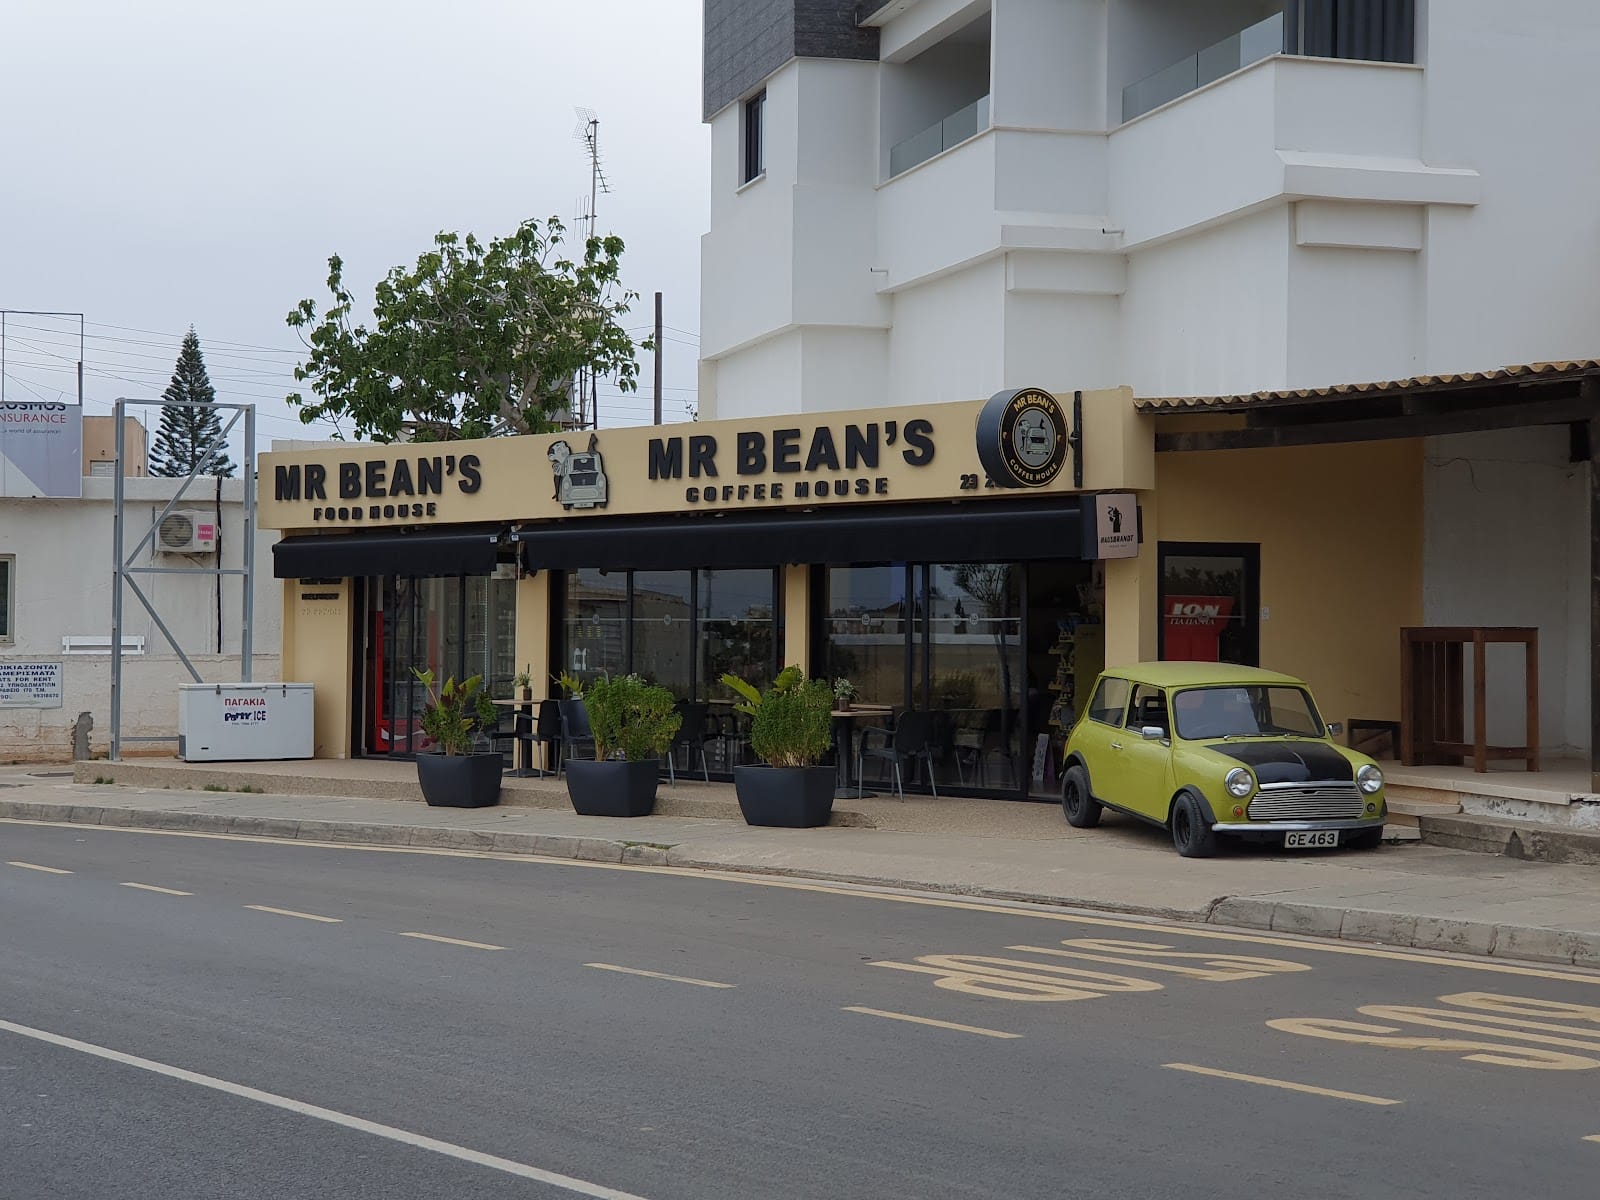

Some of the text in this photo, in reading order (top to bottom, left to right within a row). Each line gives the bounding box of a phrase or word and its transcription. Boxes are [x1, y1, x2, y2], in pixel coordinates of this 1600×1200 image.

[1013, 394, 1056, 415] MR BEAN'S
[648, 418, 936, 481] MR BEAN'S
[274, 454, 482, 502] MR BEAN'S
[1008, 458, 1035, 482] COFFEE
[1034, 462, 1058, 482] HOUSE
[685, 477, 889, 503] COFFEE HOUSE
[312, 502, 437, 521] FOOD HOUSE
[1172, 603, 1220, 618] ION
[225, 698, 266, 706] ΠΑΓΑΚΙΑ
[253, 711, 266, 720] ICE
